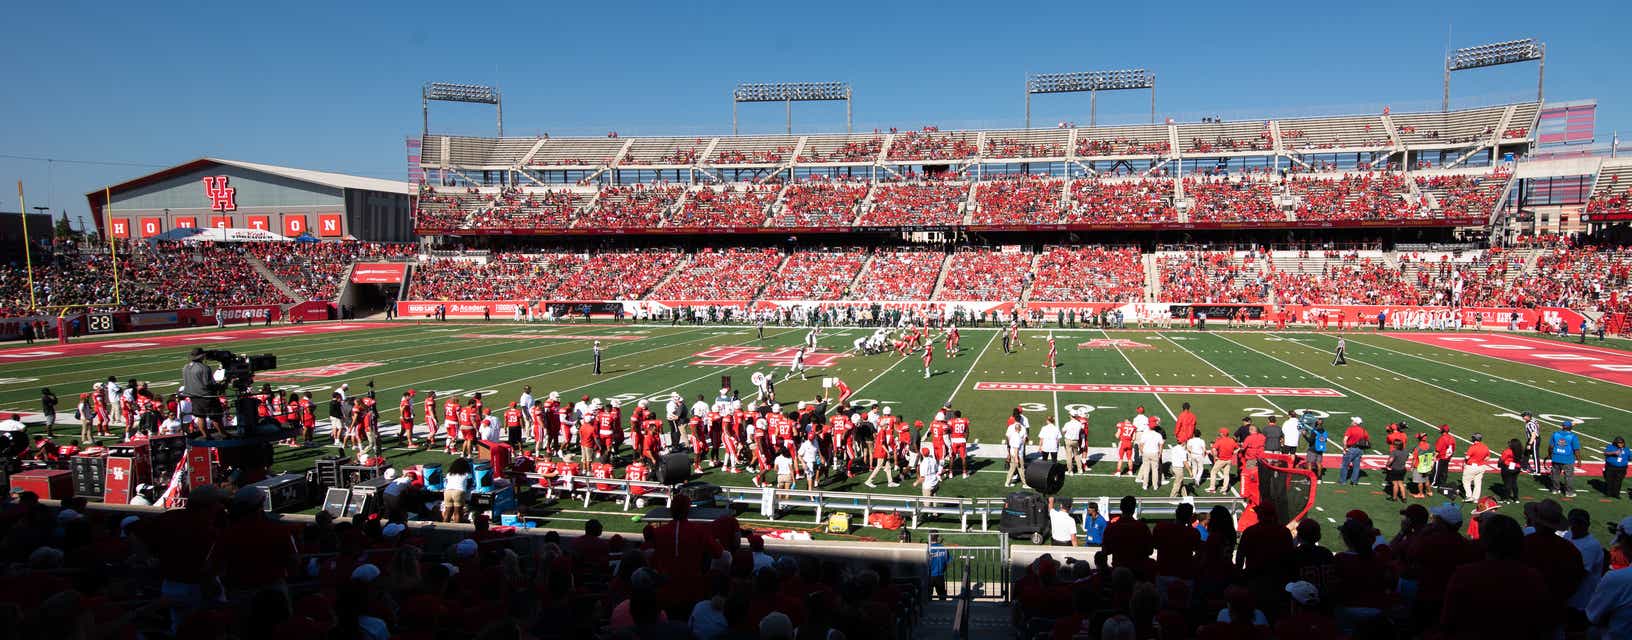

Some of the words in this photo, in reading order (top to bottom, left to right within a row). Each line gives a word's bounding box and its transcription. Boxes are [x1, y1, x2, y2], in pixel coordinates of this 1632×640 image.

[204, 176, 235, 210] UH
[90, 315, 110, 330] 28
[1018, 402, 1096, 413] 30
[1243, 407, 1330, 418] 20
[779, 425, 790, 434] 87
[954, 424, 965, 433] 80
[1122, 427, 1134, 436] 37
